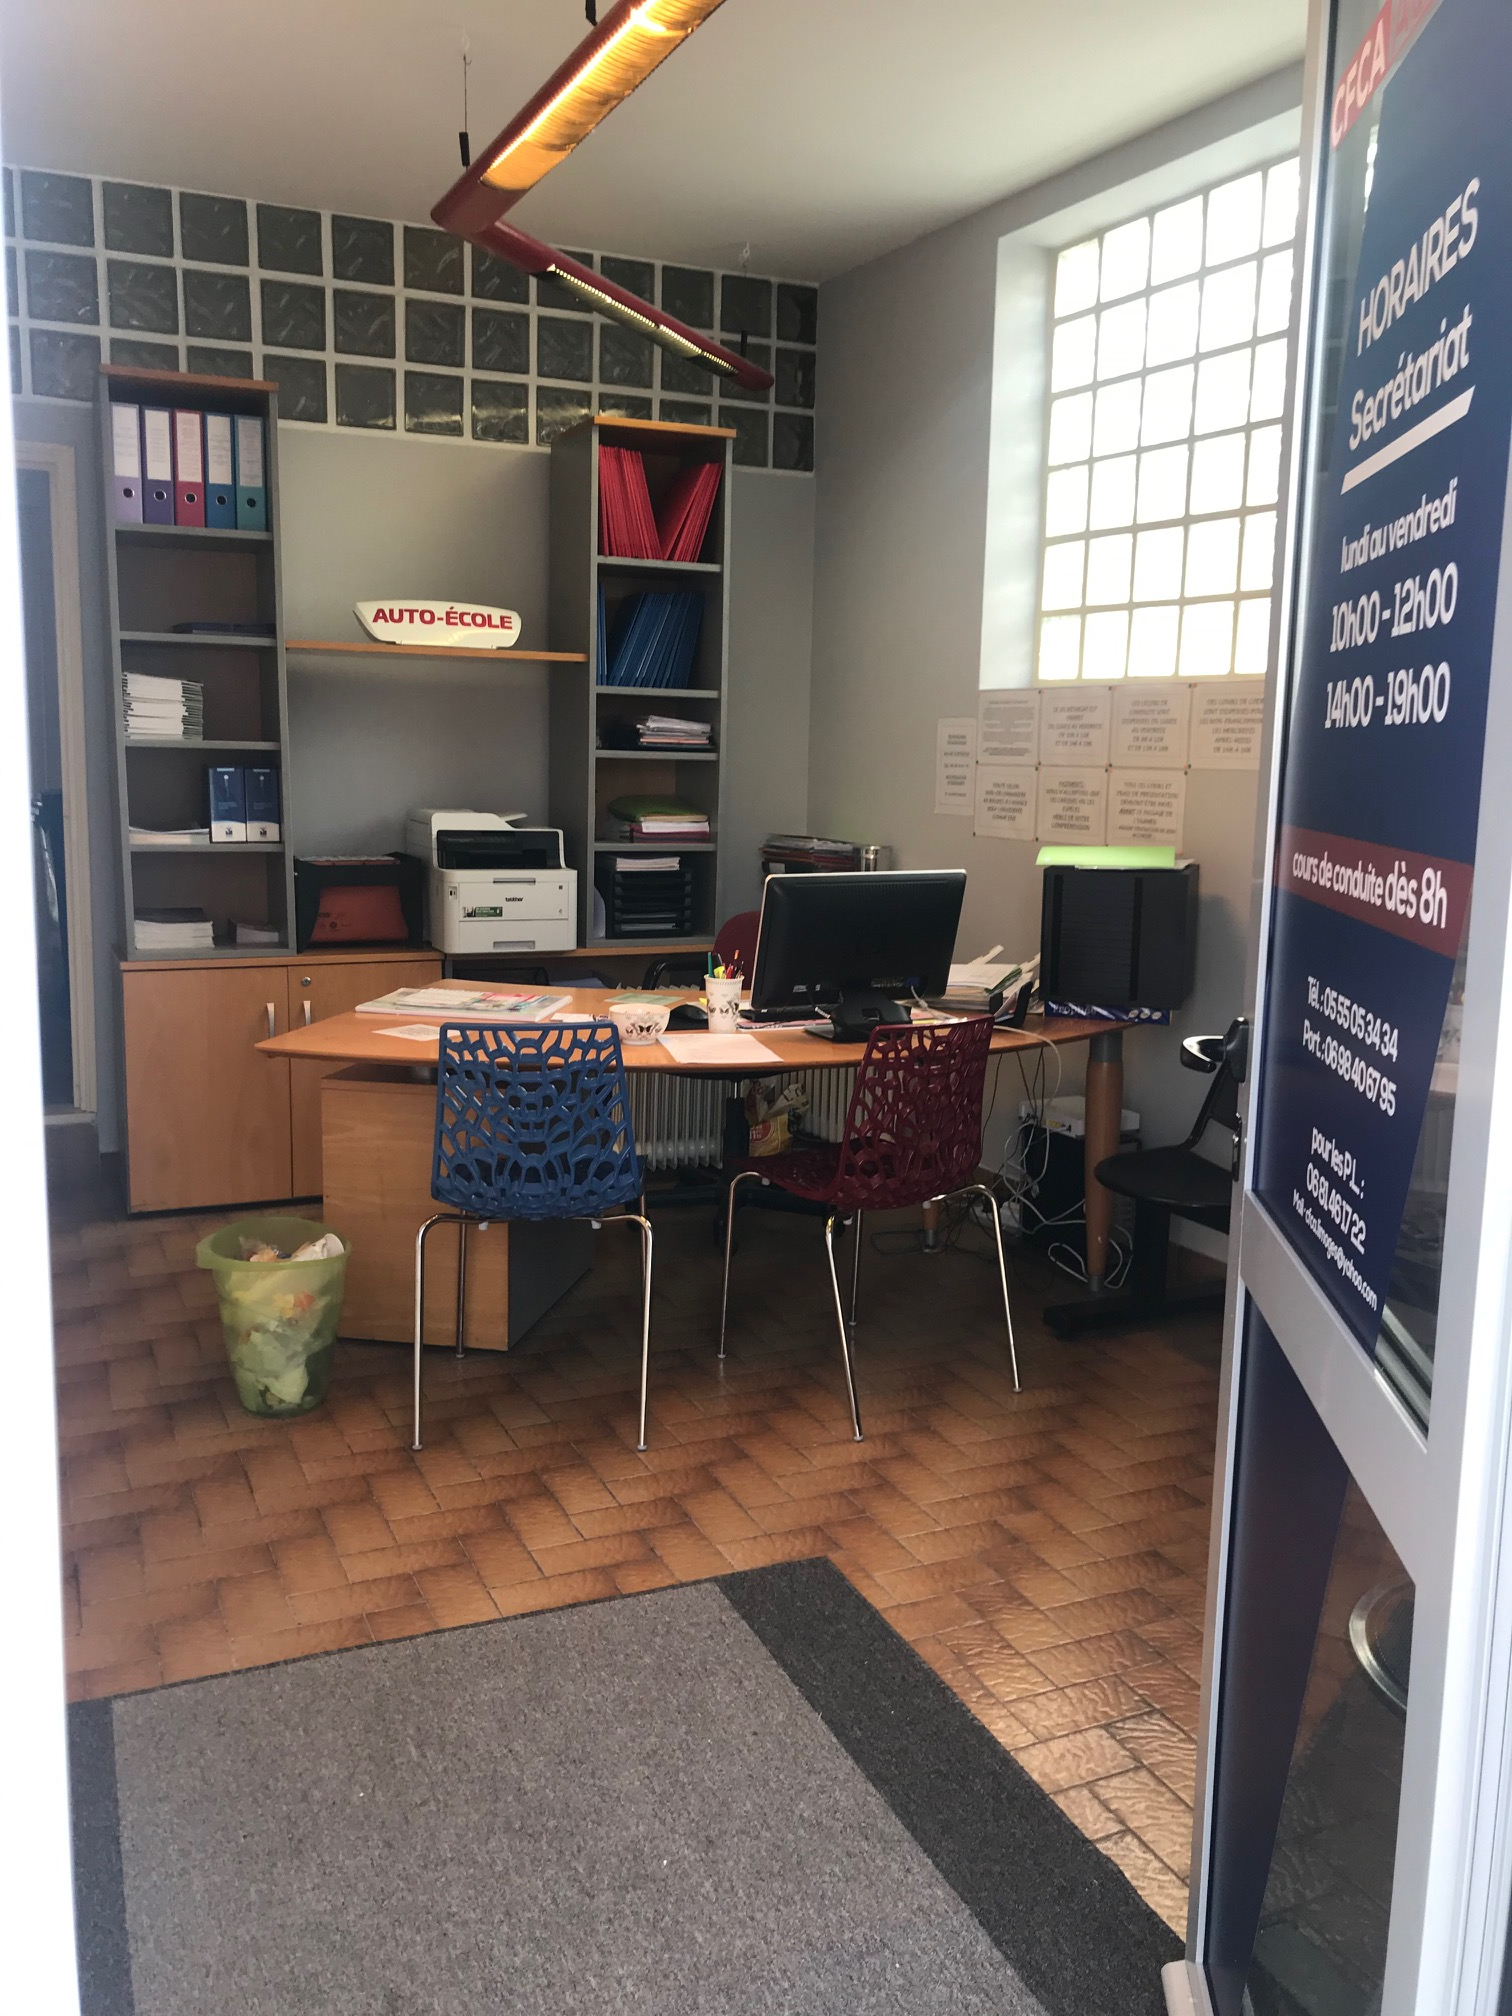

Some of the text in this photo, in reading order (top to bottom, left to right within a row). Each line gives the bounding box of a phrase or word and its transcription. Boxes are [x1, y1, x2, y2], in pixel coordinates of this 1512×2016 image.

[1331, 18, 1387, 148] CFCA
[1356, 177, 1480, 357] HORAIRES
[1349, 302, 1473, 451] Secrétariat
[1340, 476, 1458, 573] lundi au vendredi
[372, 606, 513, 630] AUTO-ÉCOLE
[1329, 590, 1381, 653] 10h00
[1391, 562, 1458, 638] 12h00
[1324, 674, 1374, 729] 14h00
[1384, 661, 1451, 726] 19h00
[1292, 850, 1448, 929] cours de conduite dès 8h
[1311, 1126, 1332, 1163] pour
[1330, 1138, 1345, 1178] les
[1306, 1162, 1367, 1256] 06 81 46 17 22
